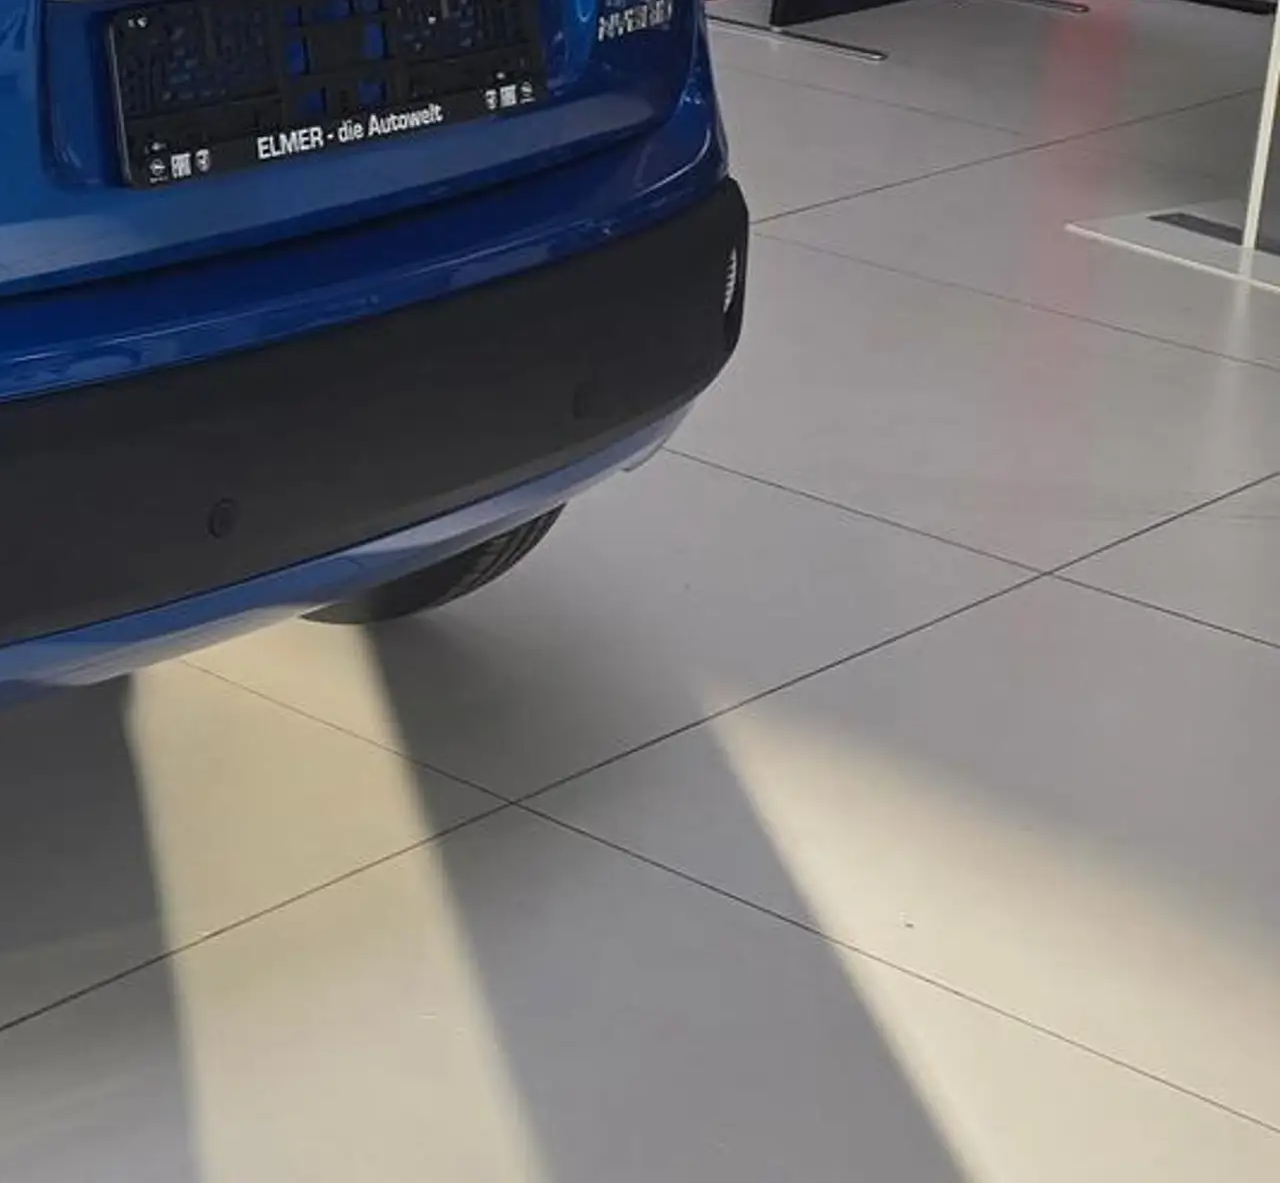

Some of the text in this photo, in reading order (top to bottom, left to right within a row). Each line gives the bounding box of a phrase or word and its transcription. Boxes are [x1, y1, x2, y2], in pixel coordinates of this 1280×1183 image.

[258, 127, 324, 159] ELMER
[338, 118, 364, 145] die
[368, 103, 443, 136] Autowelt
